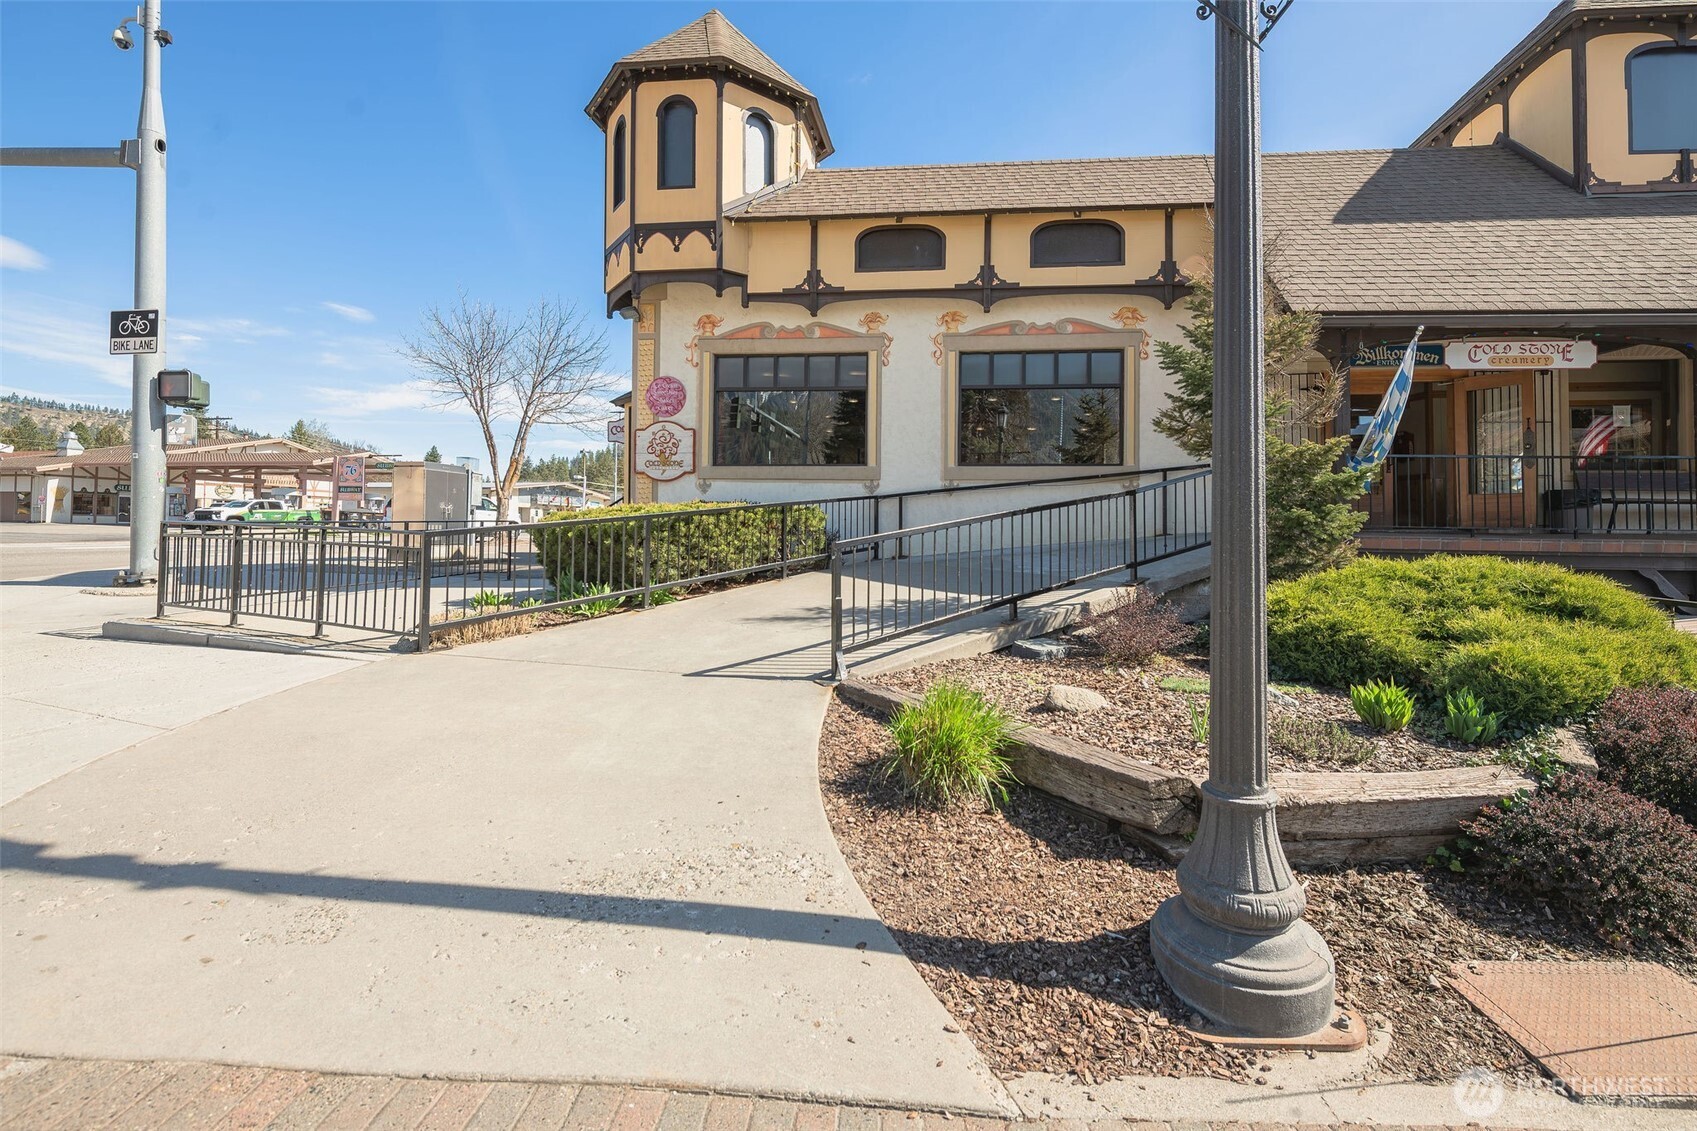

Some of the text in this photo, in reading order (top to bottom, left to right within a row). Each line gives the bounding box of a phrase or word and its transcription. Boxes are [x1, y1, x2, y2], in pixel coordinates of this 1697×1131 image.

[113, 339, 154, 351] BIKE LANE
[1467, 343, 1575, 364] COLD STONE
[1491, 356, 1550, 366] creamery
